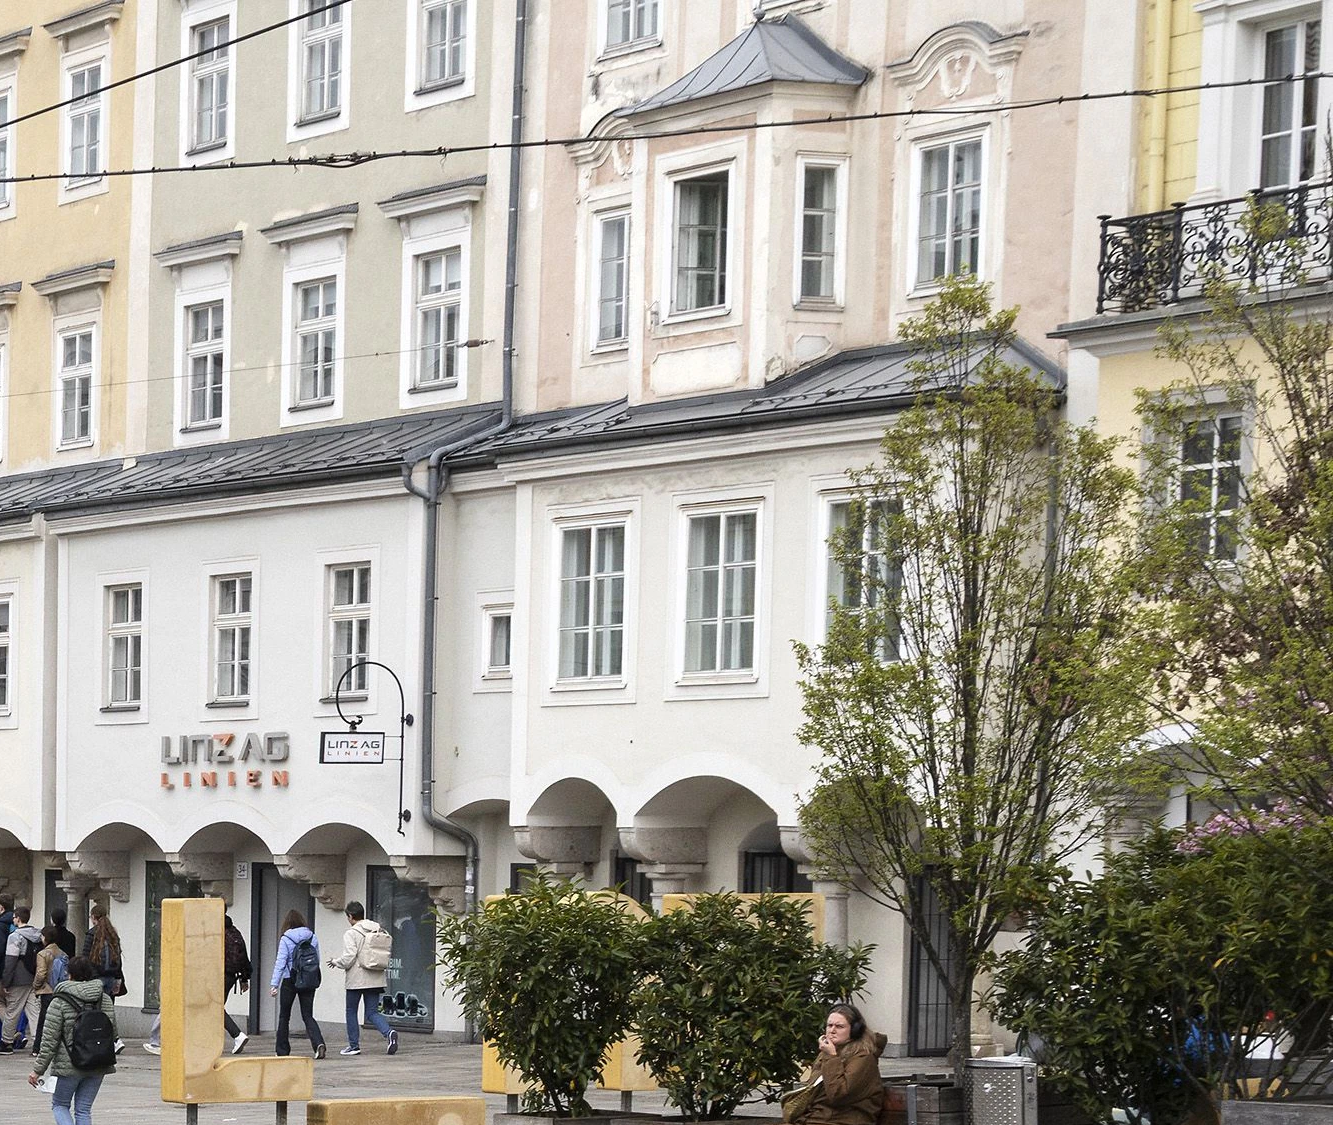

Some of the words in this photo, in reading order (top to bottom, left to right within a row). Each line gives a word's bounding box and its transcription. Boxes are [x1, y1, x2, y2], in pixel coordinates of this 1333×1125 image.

[161, 733, 235, 765] LINZ
[237, 731, 290, 763] AG
[327, 740, 358, 749] LINZ
[360, 740, 380, 749] AG
[161, 770, 290, 790] LINIEN
